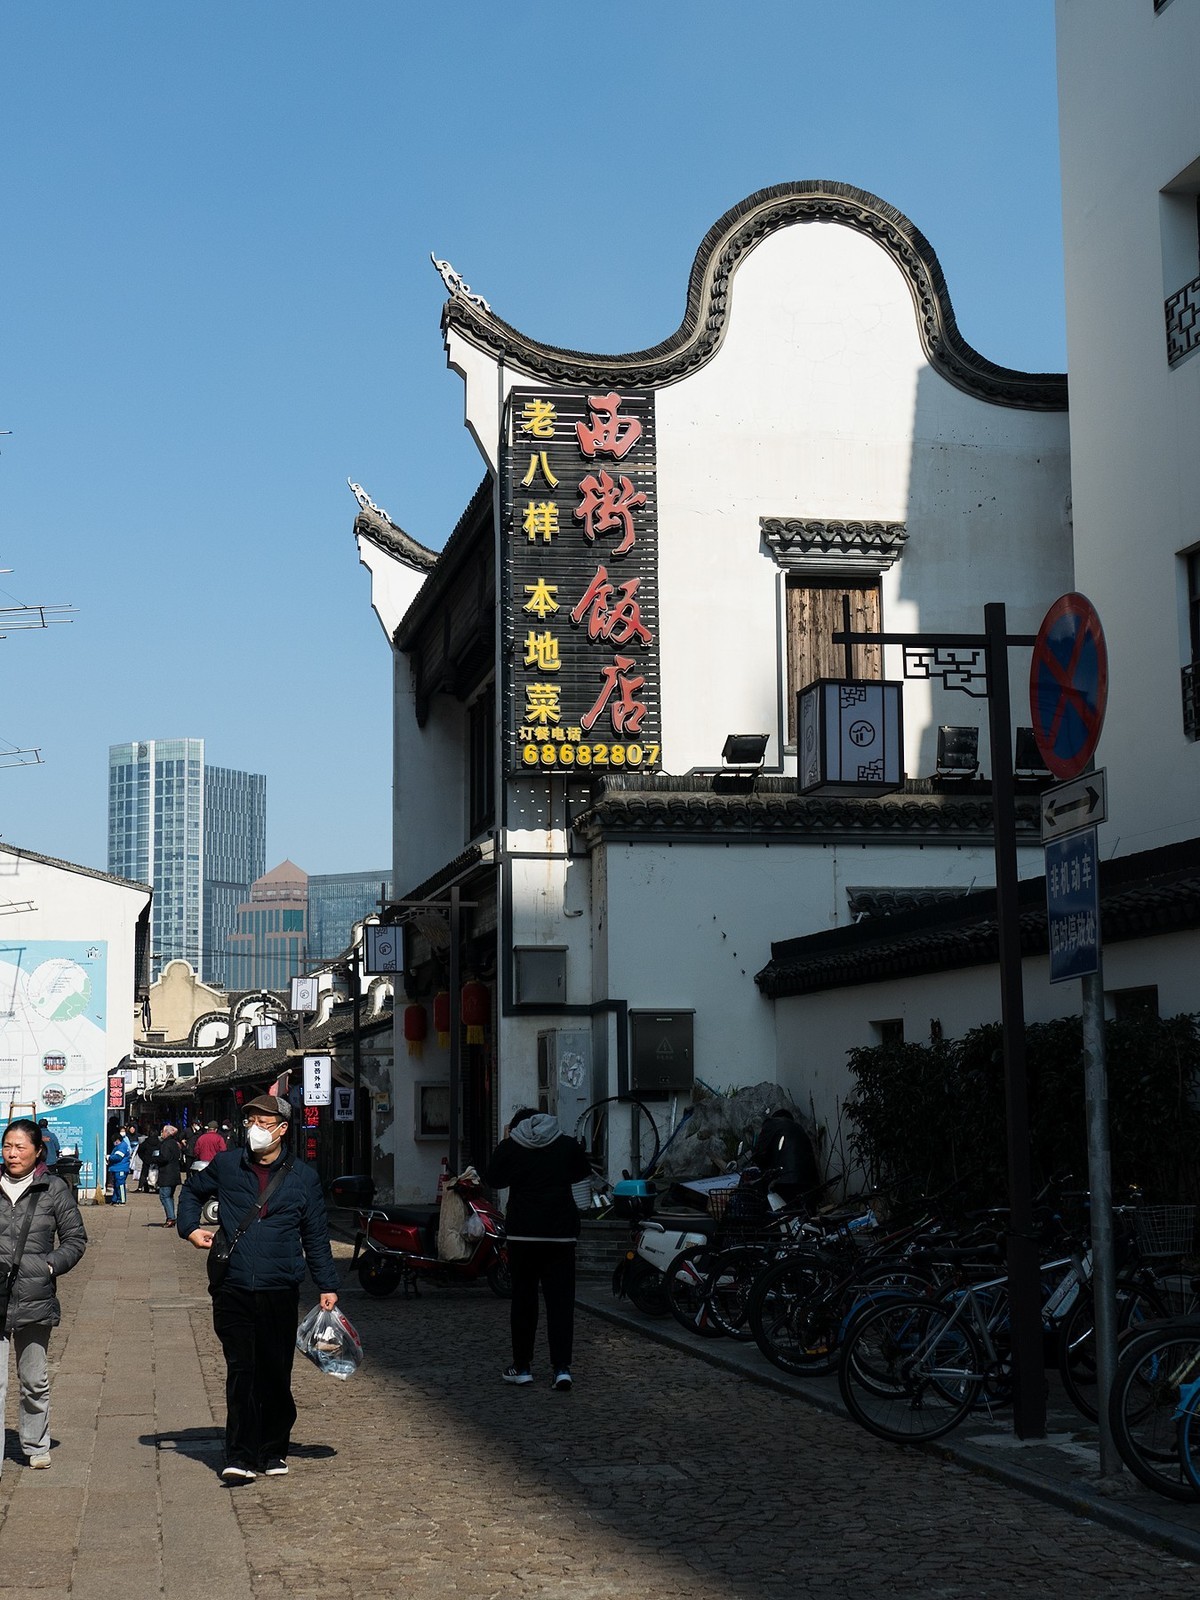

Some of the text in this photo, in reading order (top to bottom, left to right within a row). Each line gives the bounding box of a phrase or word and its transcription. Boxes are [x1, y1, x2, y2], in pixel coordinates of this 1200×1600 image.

[521, 399, 562, 725] 老八样 本地菜
[570, 391, 655, 734] 西街饭店
[518, 726, 582, 742] 订餐电话
[522, 743, 661, 766] 68682807
[1050, 853, 1091, 898] 非机动车
[1051, 911, 1095, 955] 临时停放处
